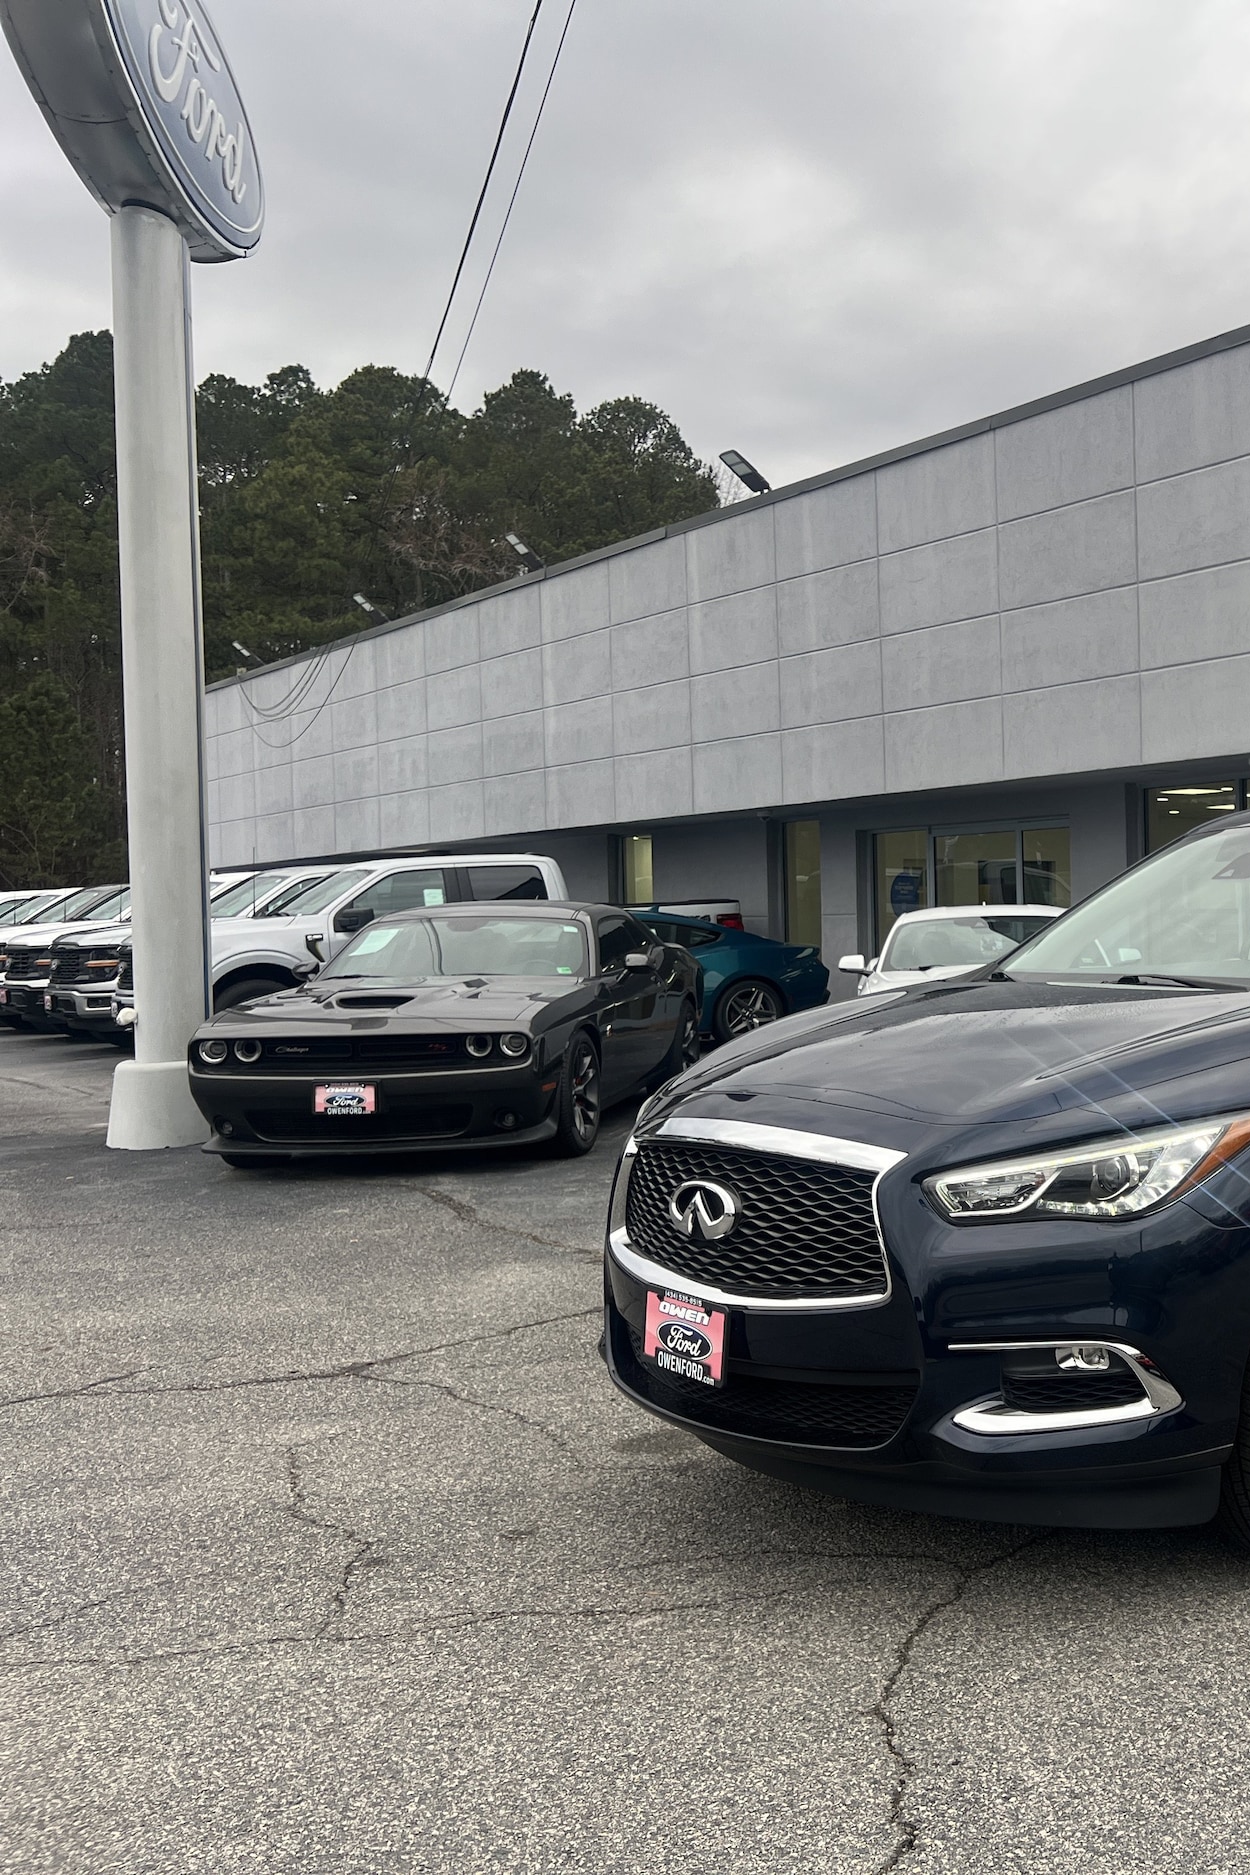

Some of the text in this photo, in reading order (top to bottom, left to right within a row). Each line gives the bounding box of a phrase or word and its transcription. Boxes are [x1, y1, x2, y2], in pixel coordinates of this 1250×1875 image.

[149, 0, 247, 204] Ford
[332, 1095, 359, 1106] Ford
[658, 1300, 710, 1326] OWEN
[667, 1325, 702, 1357] Ford
[657, 1350, 715, 1386] OWENFORD.com
